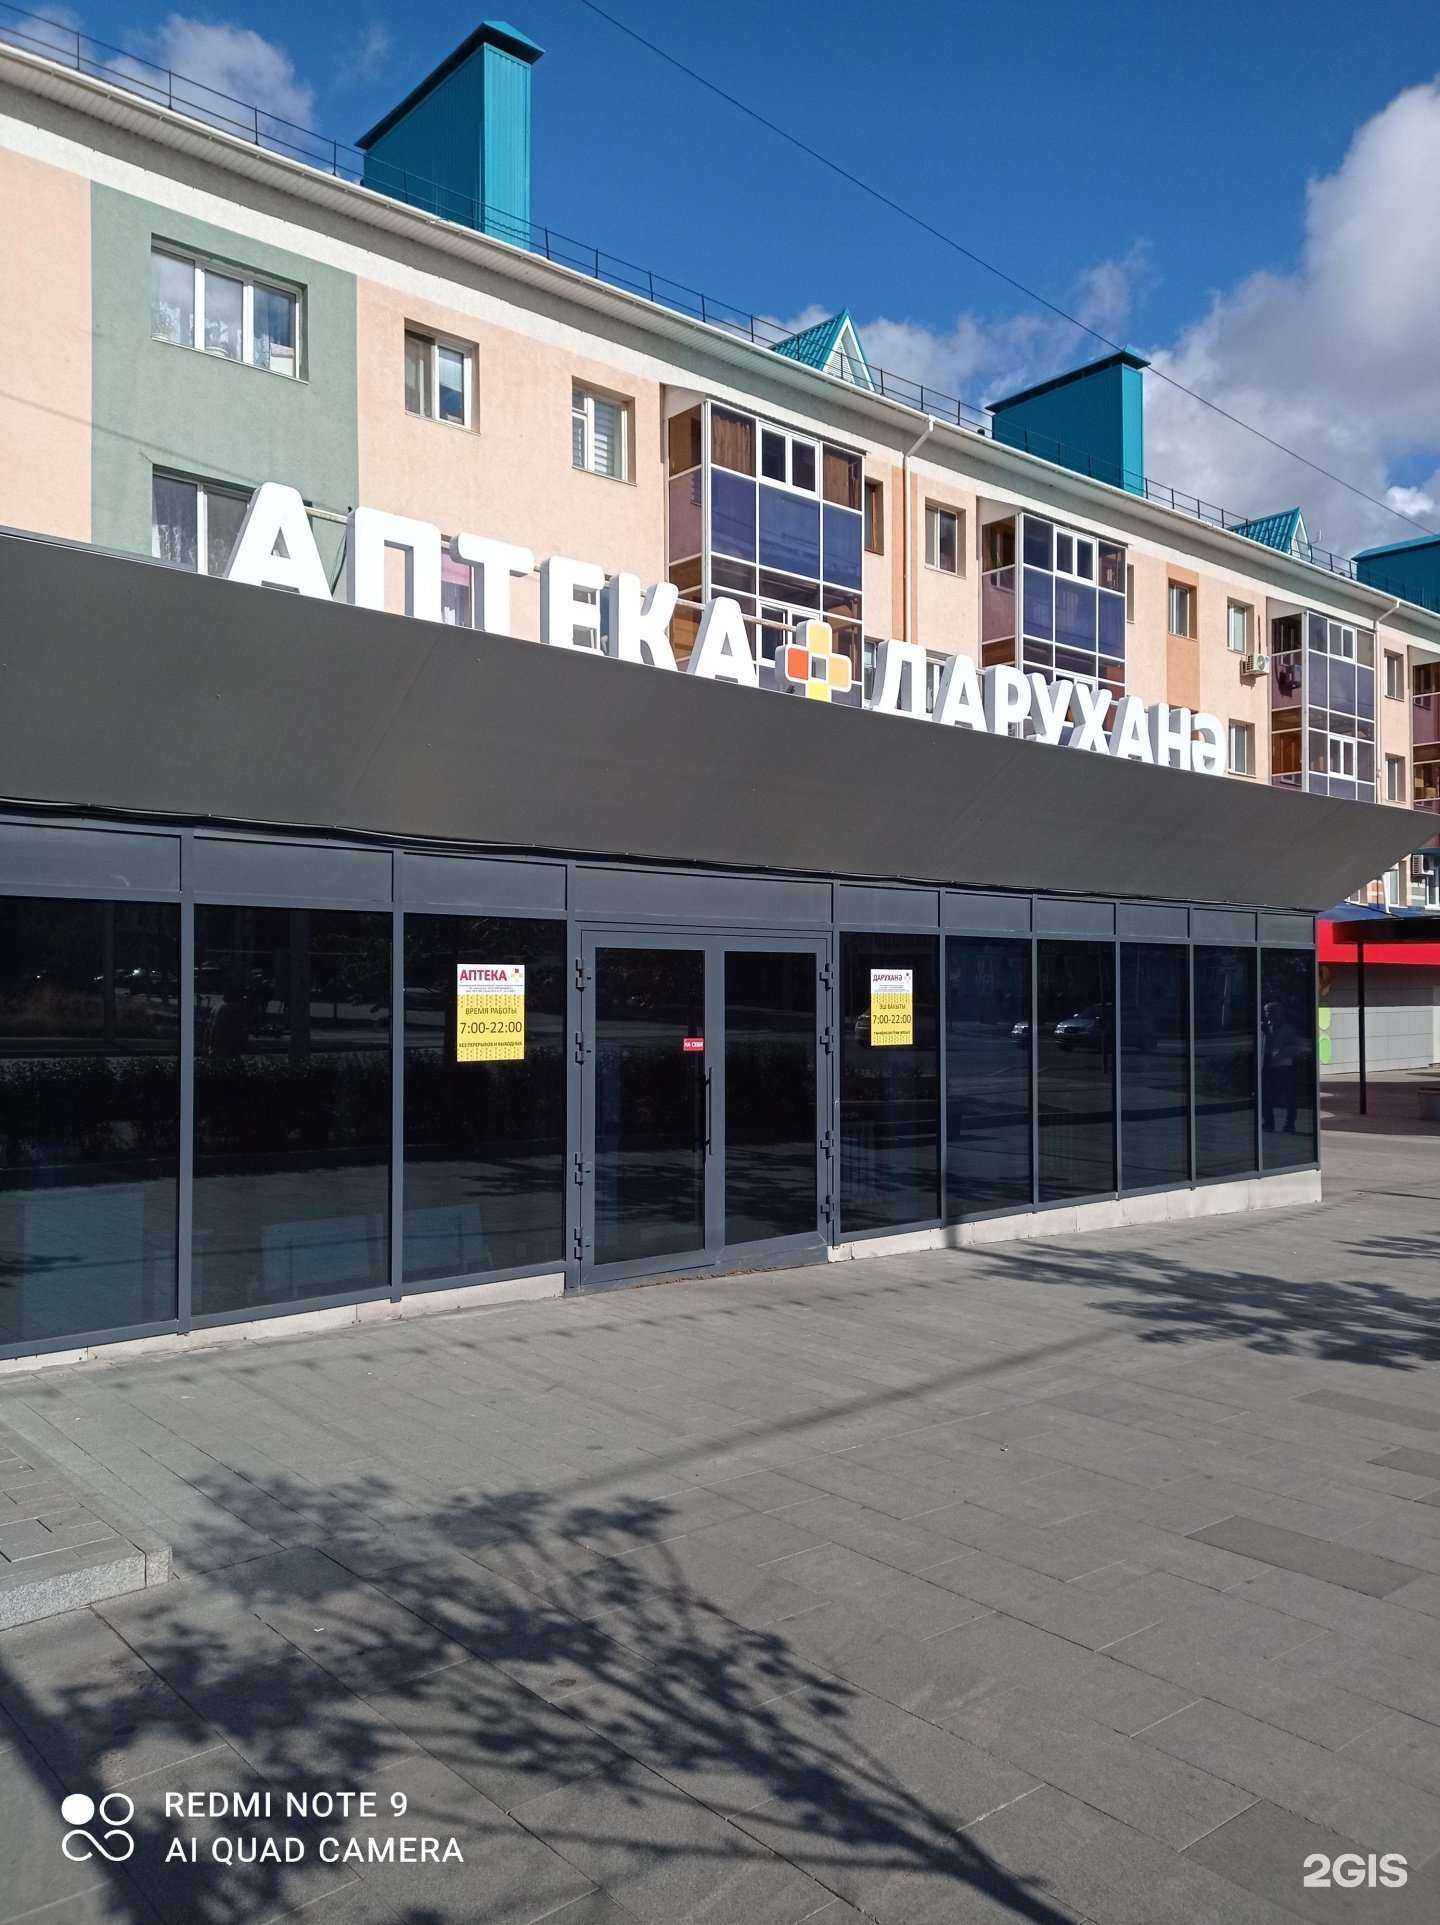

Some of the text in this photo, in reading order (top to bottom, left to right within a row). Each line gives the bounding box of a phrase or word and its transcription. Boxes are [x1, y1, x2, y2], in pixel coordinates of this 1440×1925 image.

[224, 482, 1228, 776] АПТЕКА ДАРУХАНӘ
[459, 969, 508, 981] АПТЕКА
[466, 1007, 517, 1015] ВРЕМЯ РАБОТЫ
[873, 1014, 911, 1024] 7:00-22:00
[460, 1021, 522, 1034] 7:00-22:00
